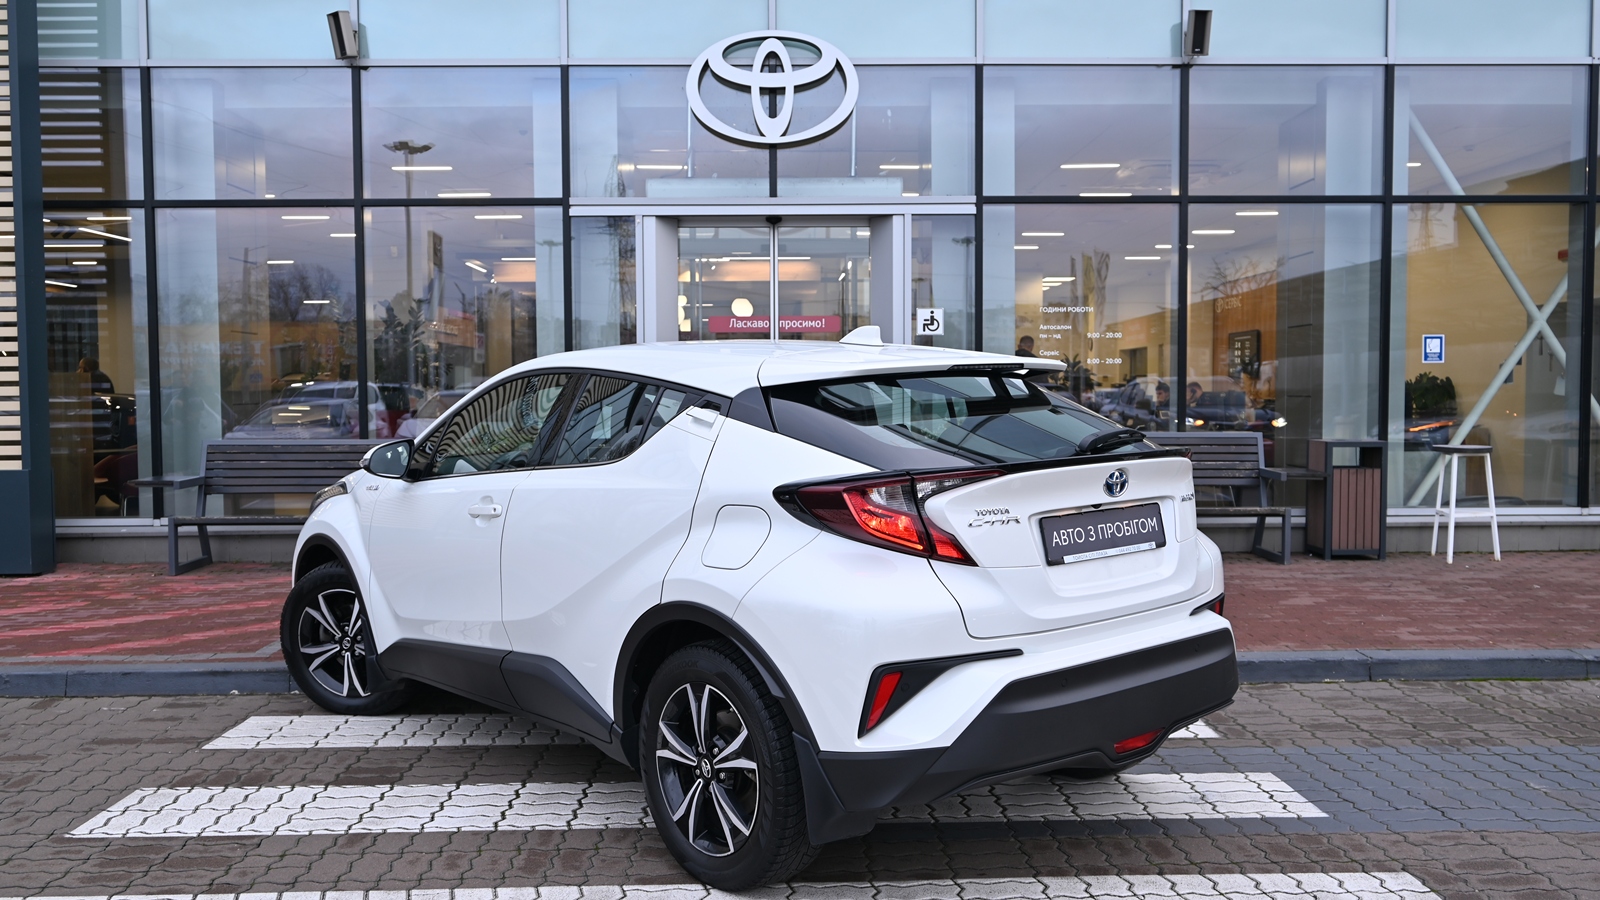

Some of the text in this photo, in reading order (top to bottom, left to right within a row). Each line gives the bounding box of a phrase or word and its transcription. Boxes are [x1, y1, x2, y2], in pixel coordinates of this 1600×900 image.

[729, 317, 826, 330] Ласкаво просимо!
[975, 506, 1010, 517] TOYOTA
[967, 516, 1021, 528] C-HR
[1052, 527, 1085, 548] АВТО
[1097, 516, 1159, 541] ПРОБІГОМ
